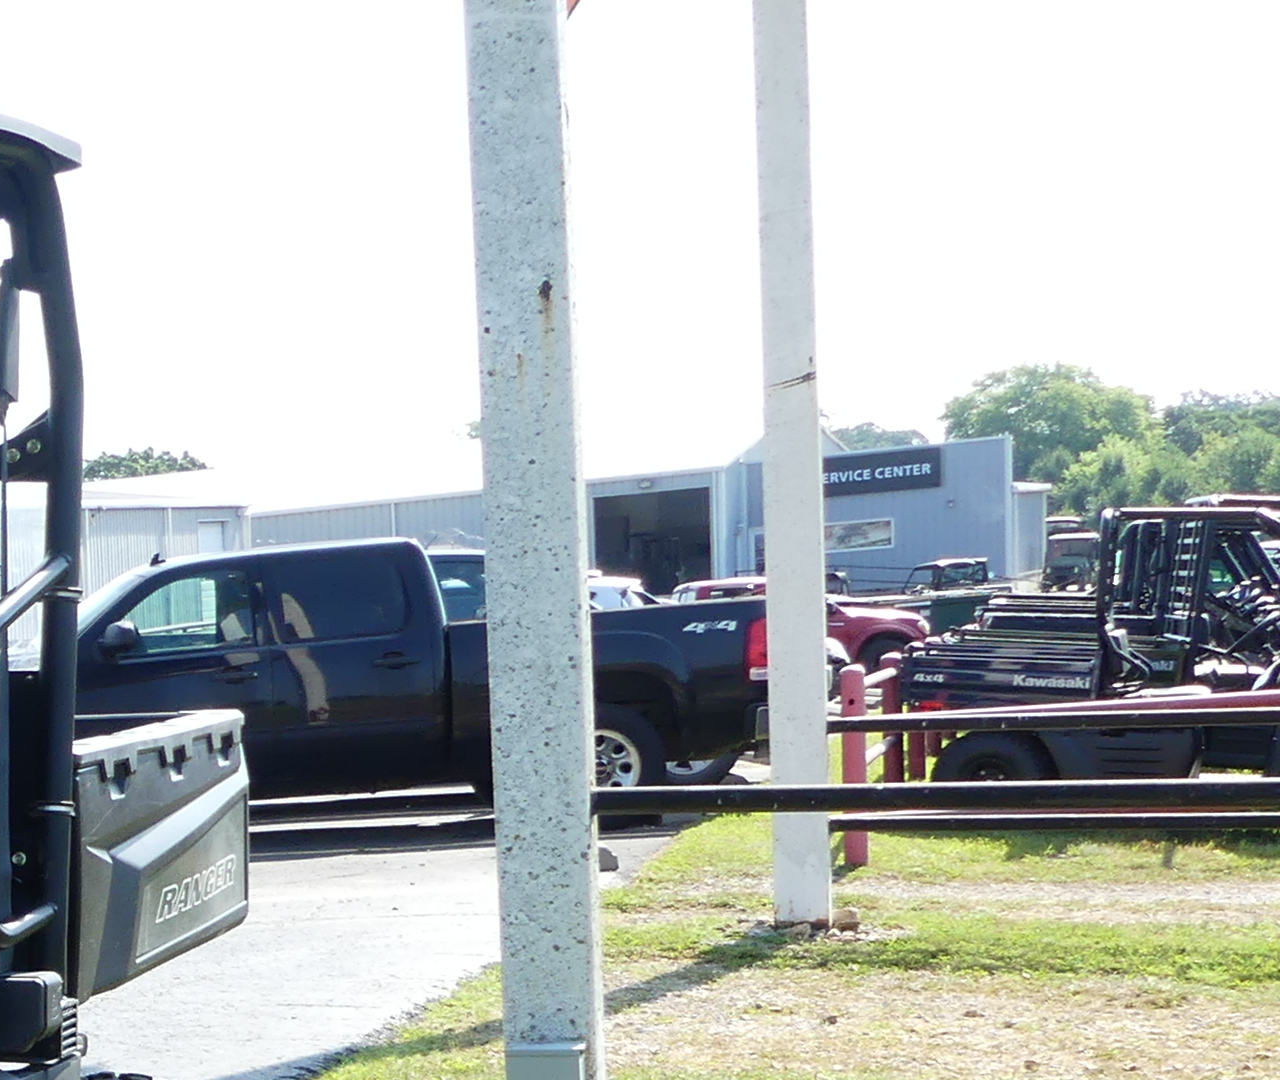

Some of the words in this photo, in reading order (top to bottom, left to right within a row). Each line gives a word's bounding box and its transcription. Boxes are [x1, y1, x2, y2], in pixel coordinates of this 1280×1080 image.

[822, 468, 871, 485] ERVICE
[874, 463, 931, 480] CENTER
[682, 620, 738, 634] 4x4
[913, 673, 944, 683] 4x4
[1013, 674, 1091, 689] Kawasaki
[155, 853, 236, 923] RANGER
